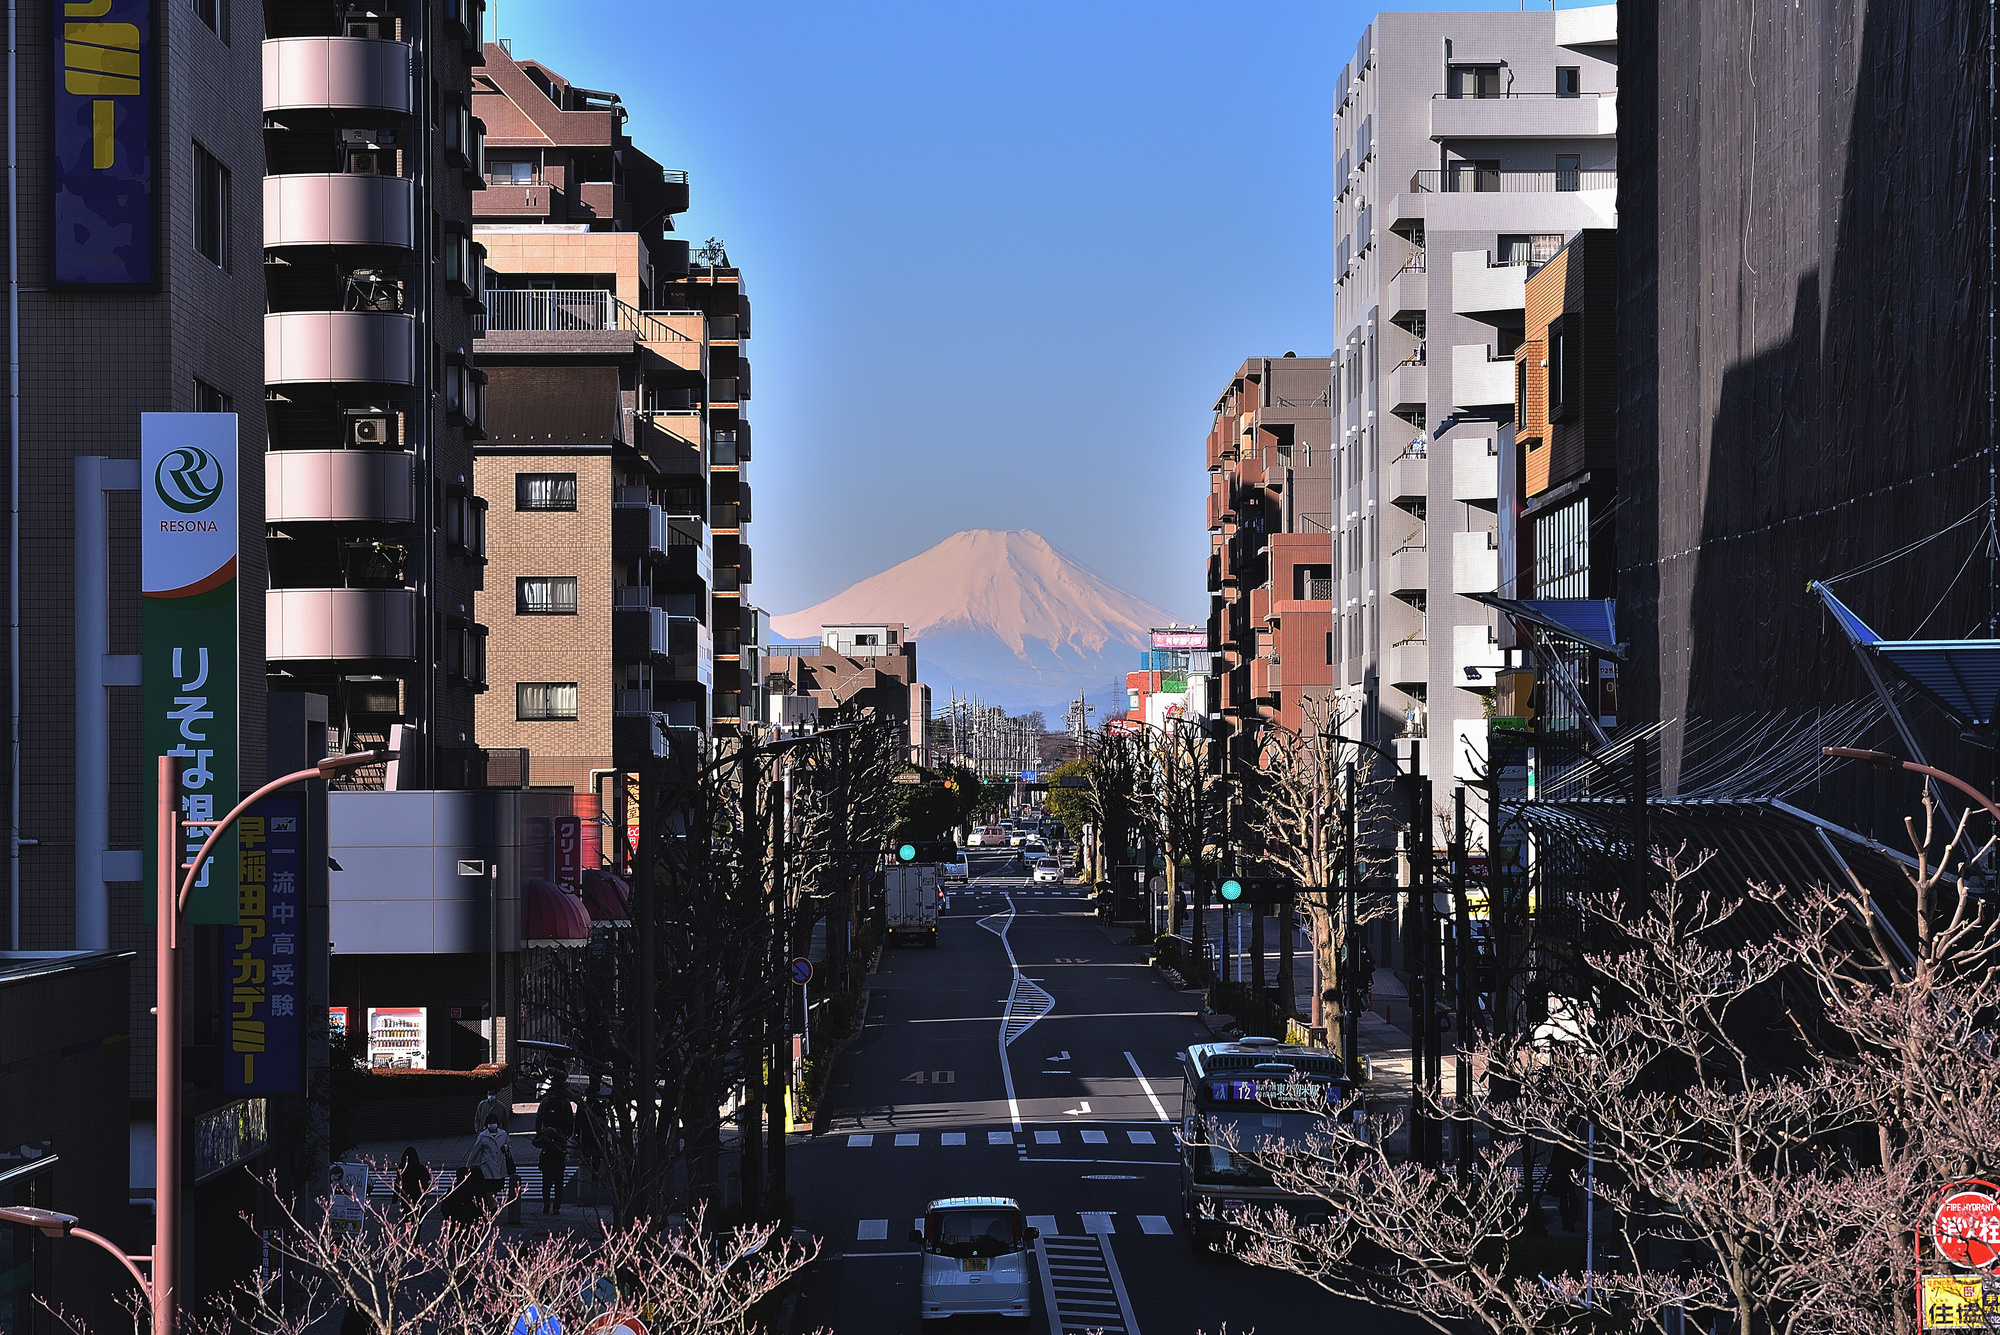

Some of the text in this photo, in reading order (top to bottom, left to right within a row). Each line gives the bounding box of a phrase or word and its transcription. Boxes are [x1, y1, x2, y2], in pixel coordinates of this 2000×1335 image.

[64, 0, 141, 169] ミー
[160, 520, 218, 532] RESONA
[270, 848, 296, 1018] 一流中高受験
[231, 815, 267, 1085] 早稲田アカデミー
[901, 1070, 955, 1085] 40
[1238, 1086, 1251, 1100] 12
[1946, 1203, 1995, 1212] FIRE HYDRANT
[1941, 1215, 2000, 1244] 消火栓
